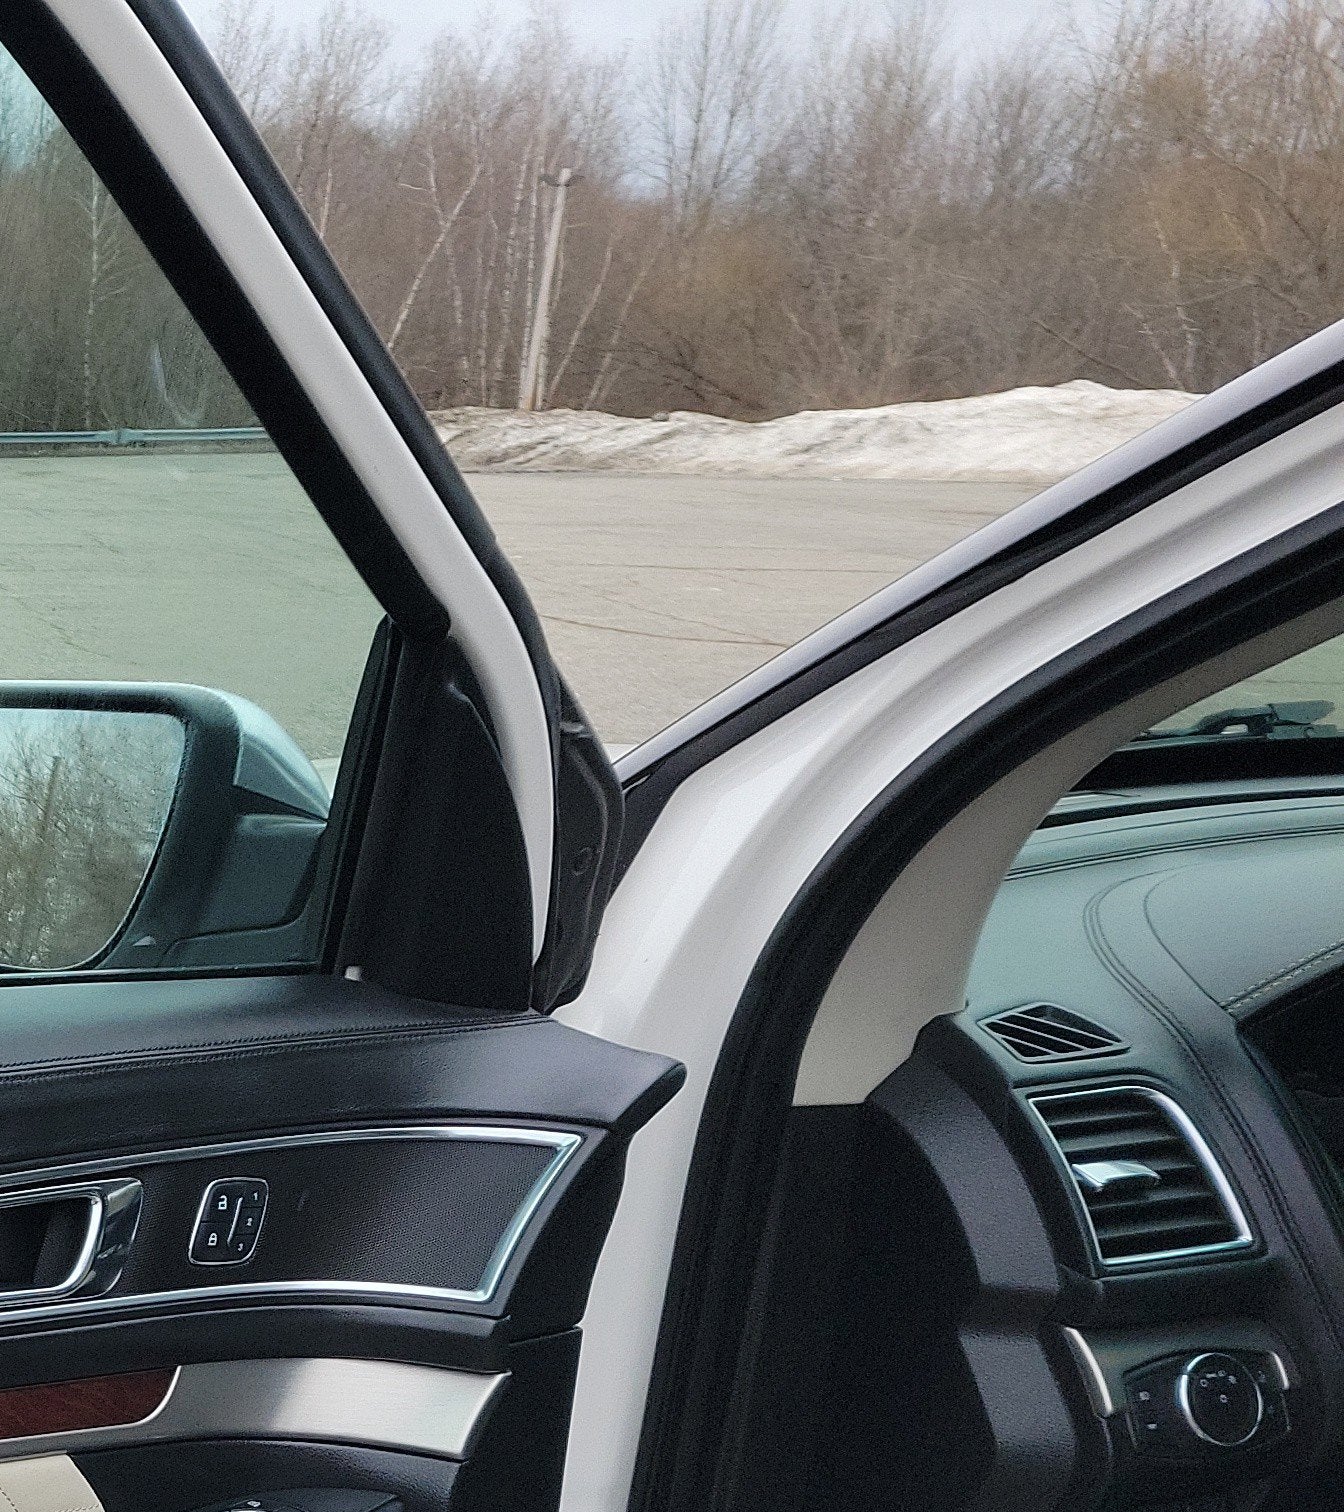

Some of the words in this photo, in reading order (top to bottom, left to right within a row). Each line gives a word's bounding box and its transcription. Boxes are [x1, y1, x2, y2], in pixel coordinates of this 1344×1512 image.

[253, 1192, 259, 1201] 1
[246, 1217, 253, 1227] 2
[237, 1242, 244, 1252] 3
